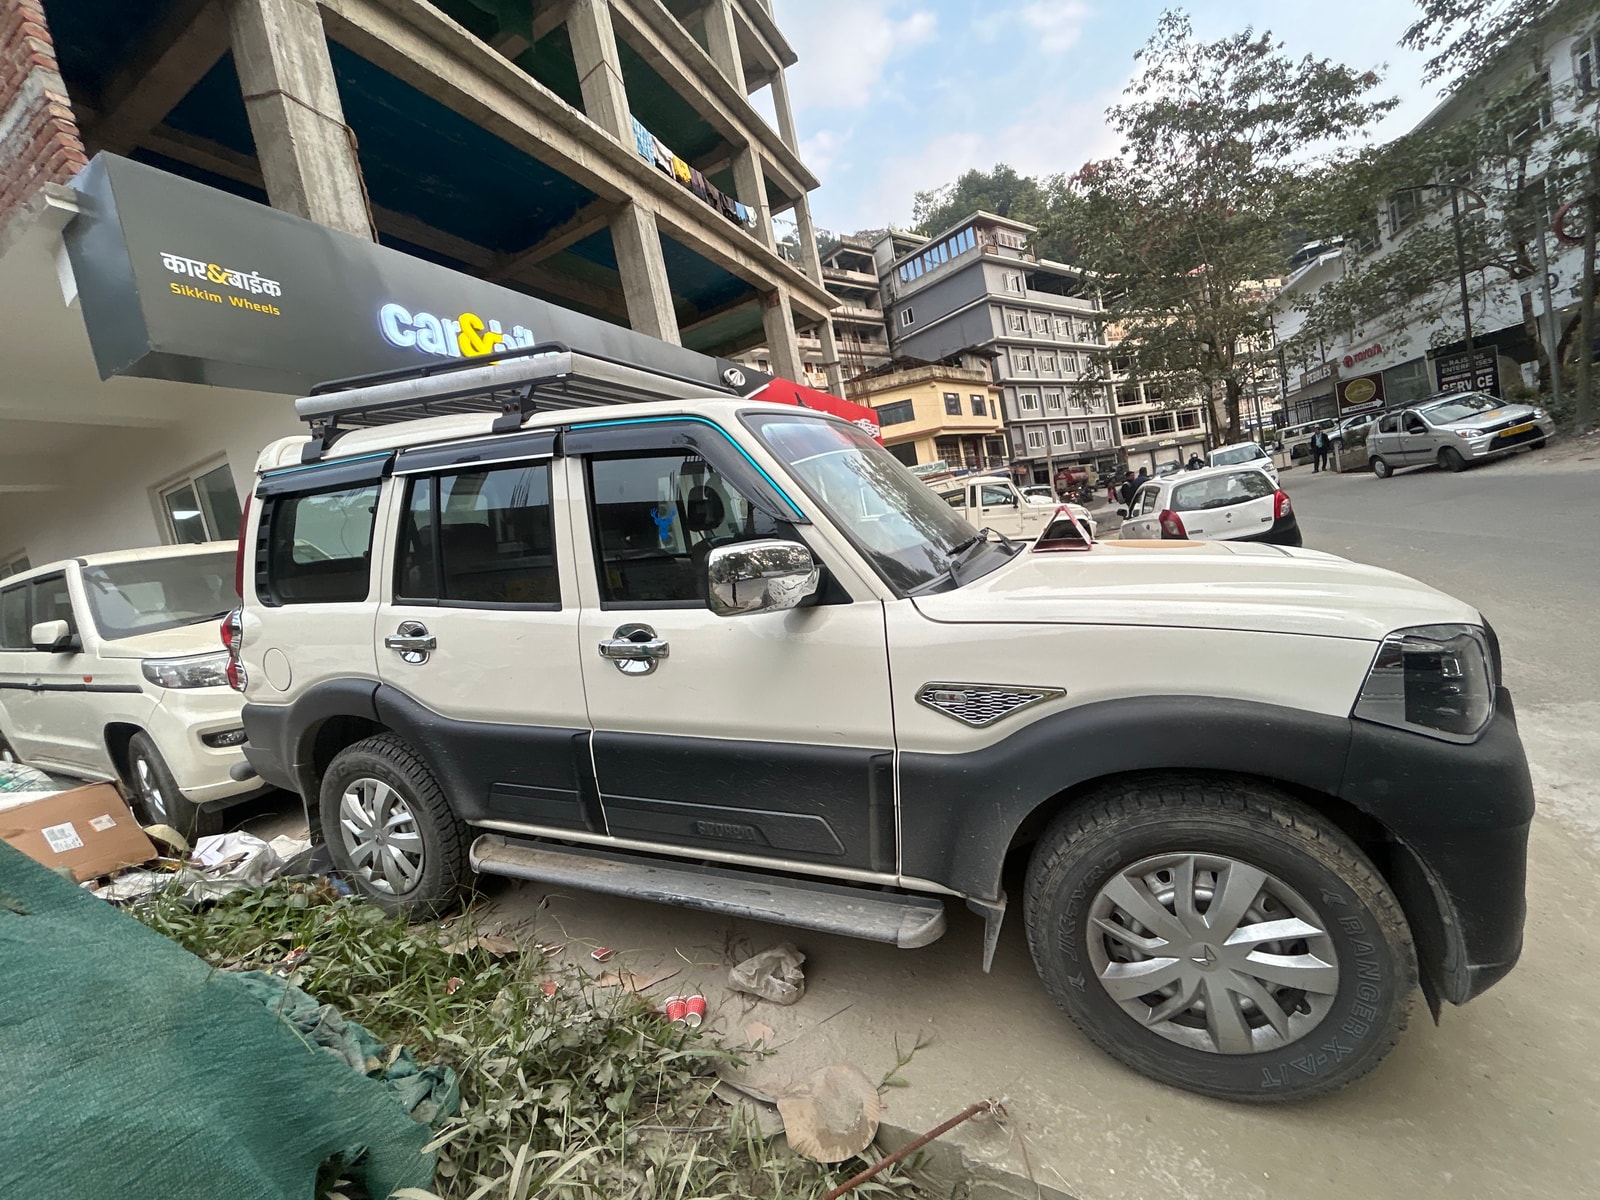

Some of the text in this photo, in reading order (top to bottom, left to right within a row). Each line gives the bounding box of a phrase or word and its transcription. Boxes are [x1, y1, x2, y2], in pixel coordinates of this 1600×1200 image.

[160, 251, 281, 297] कार&बाईक
[170, 282, 280, 316] Sikkim Wheels
[1354, 343, 1382, 363] TOYOTA
[1441, 358, 1493, 374] ENTERPISES
[1442, 374, 1494, 393] SERVCE
[1339, 915, 1382, 1040] RANGER
